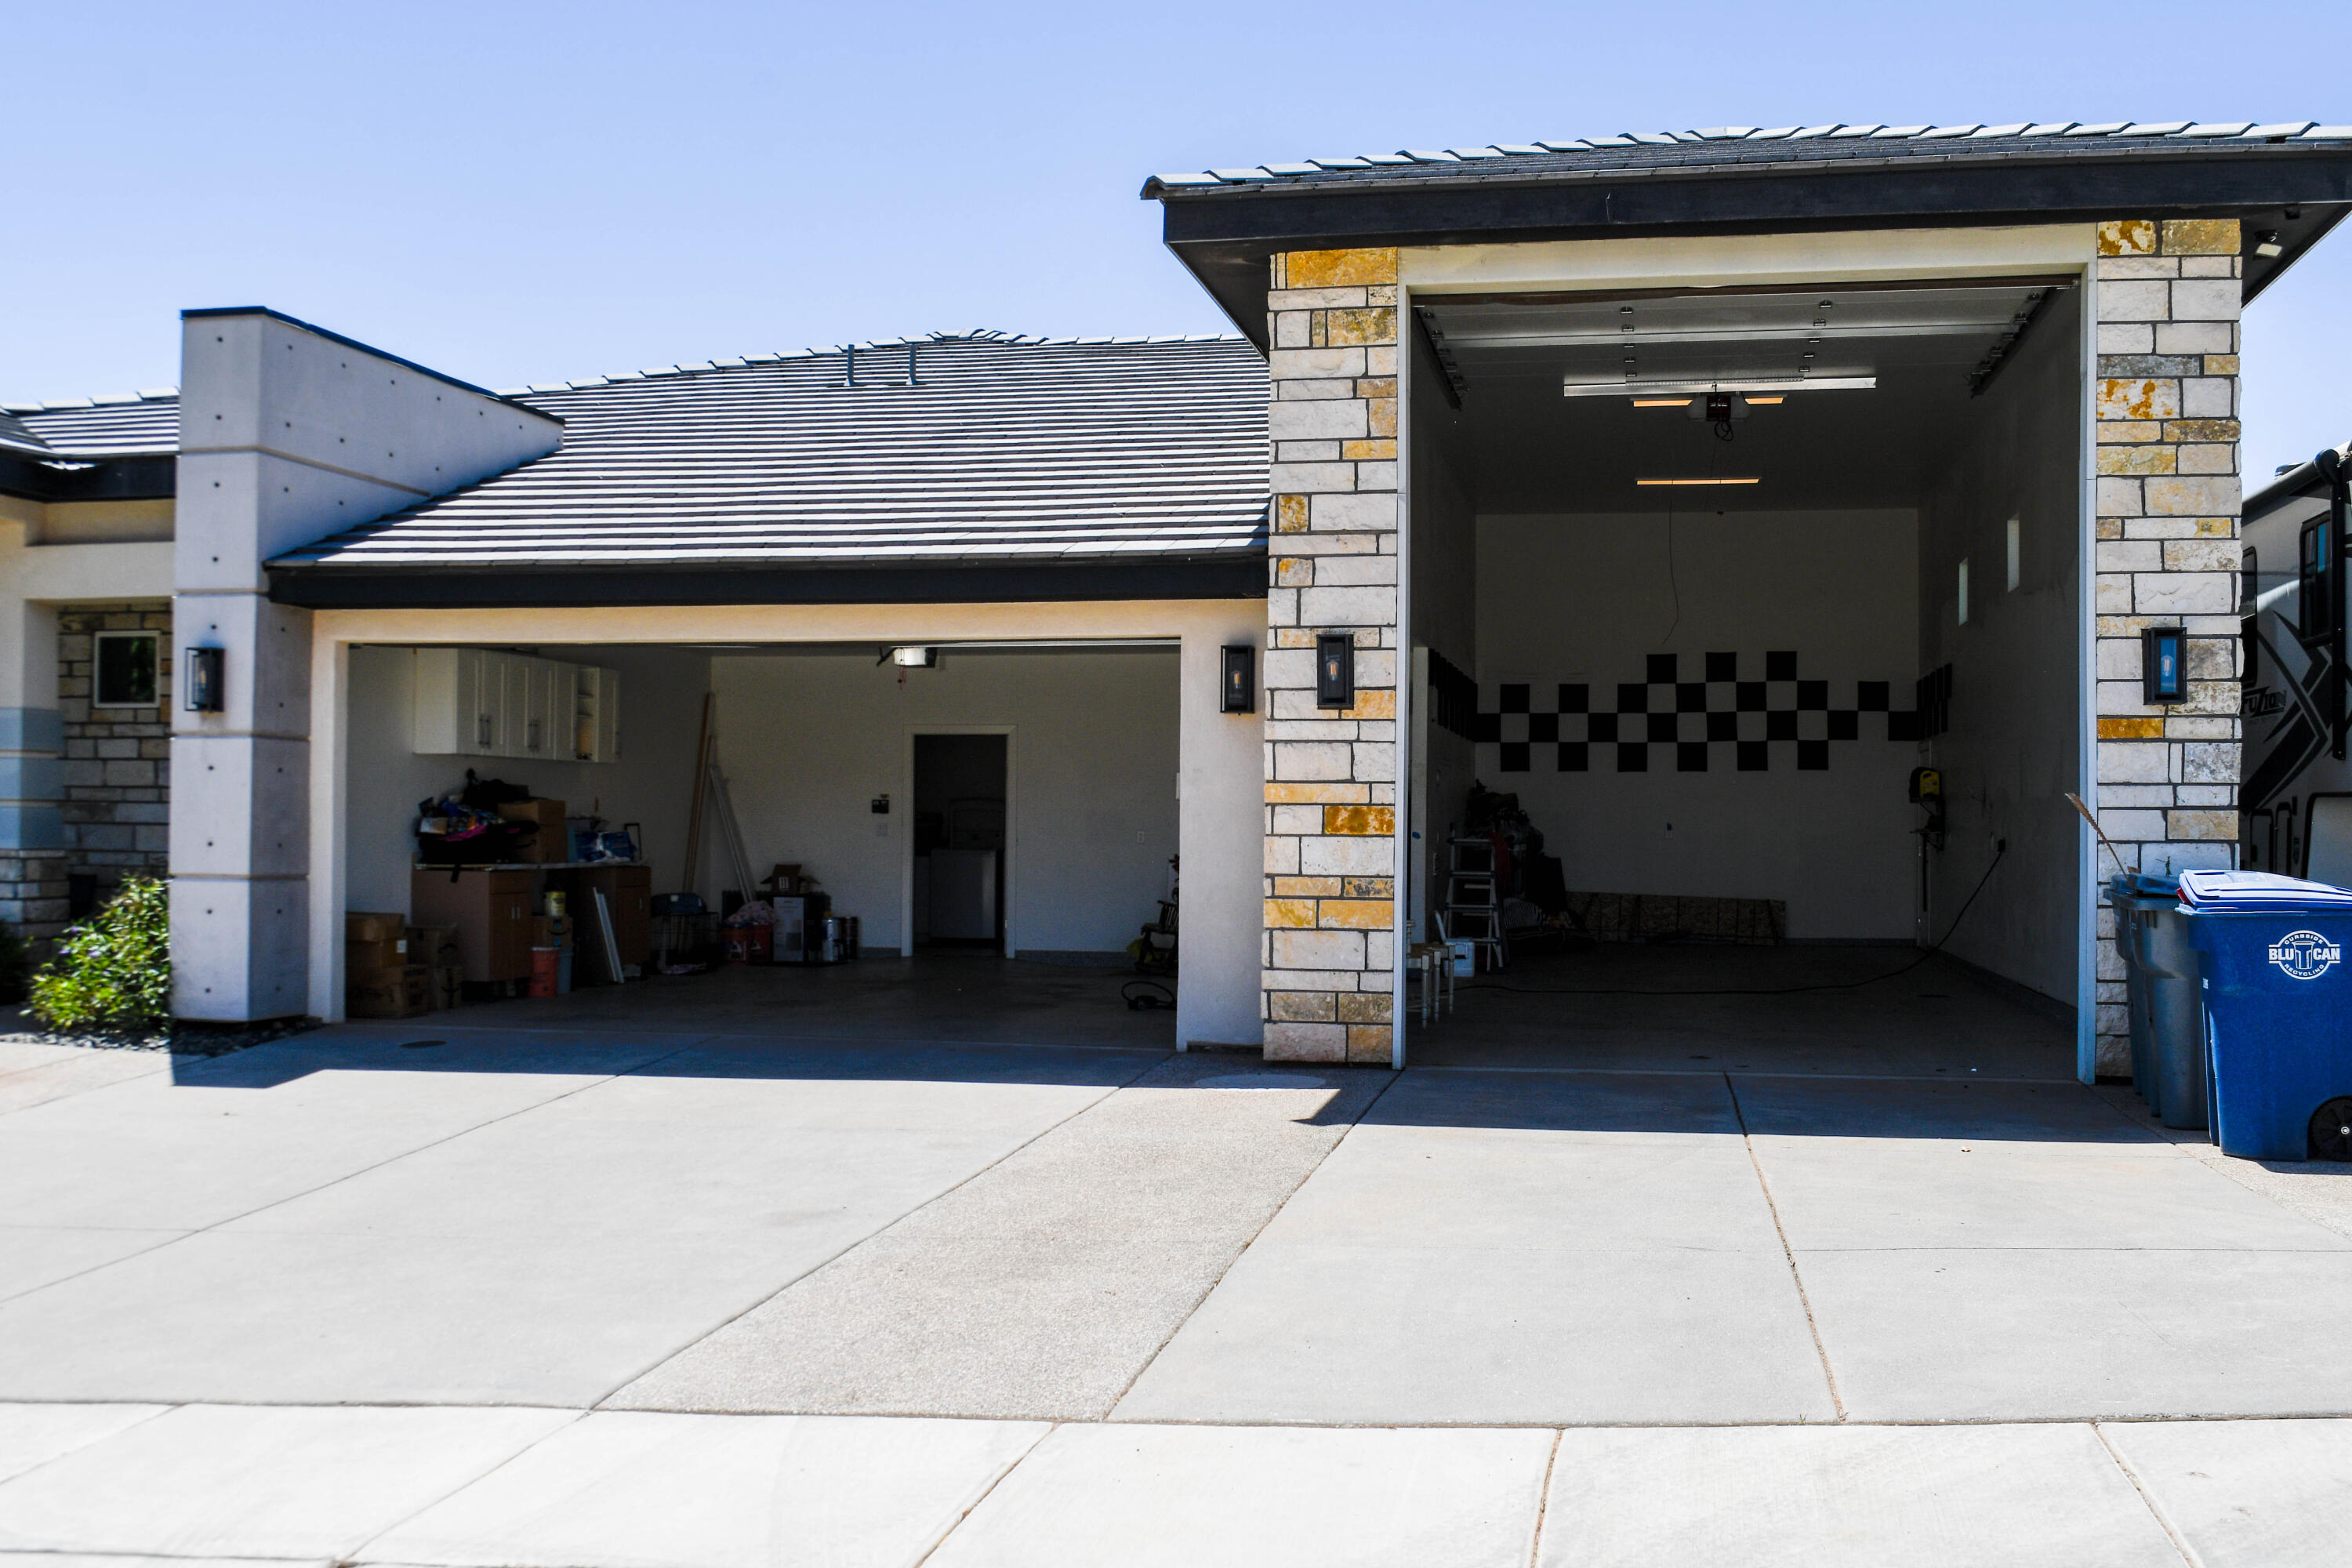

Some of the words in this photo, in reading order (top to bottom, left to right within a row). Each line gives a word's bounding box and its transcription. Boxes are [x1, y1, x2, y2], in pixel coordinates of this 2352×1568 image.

[2285, 934, 2324, 945] CURBSIDE
[2268, 948, 2294, 960] BLU
[2313, 948, 2340, 960] CAN
[2284, 964, 2325, 976] RECYCLING
